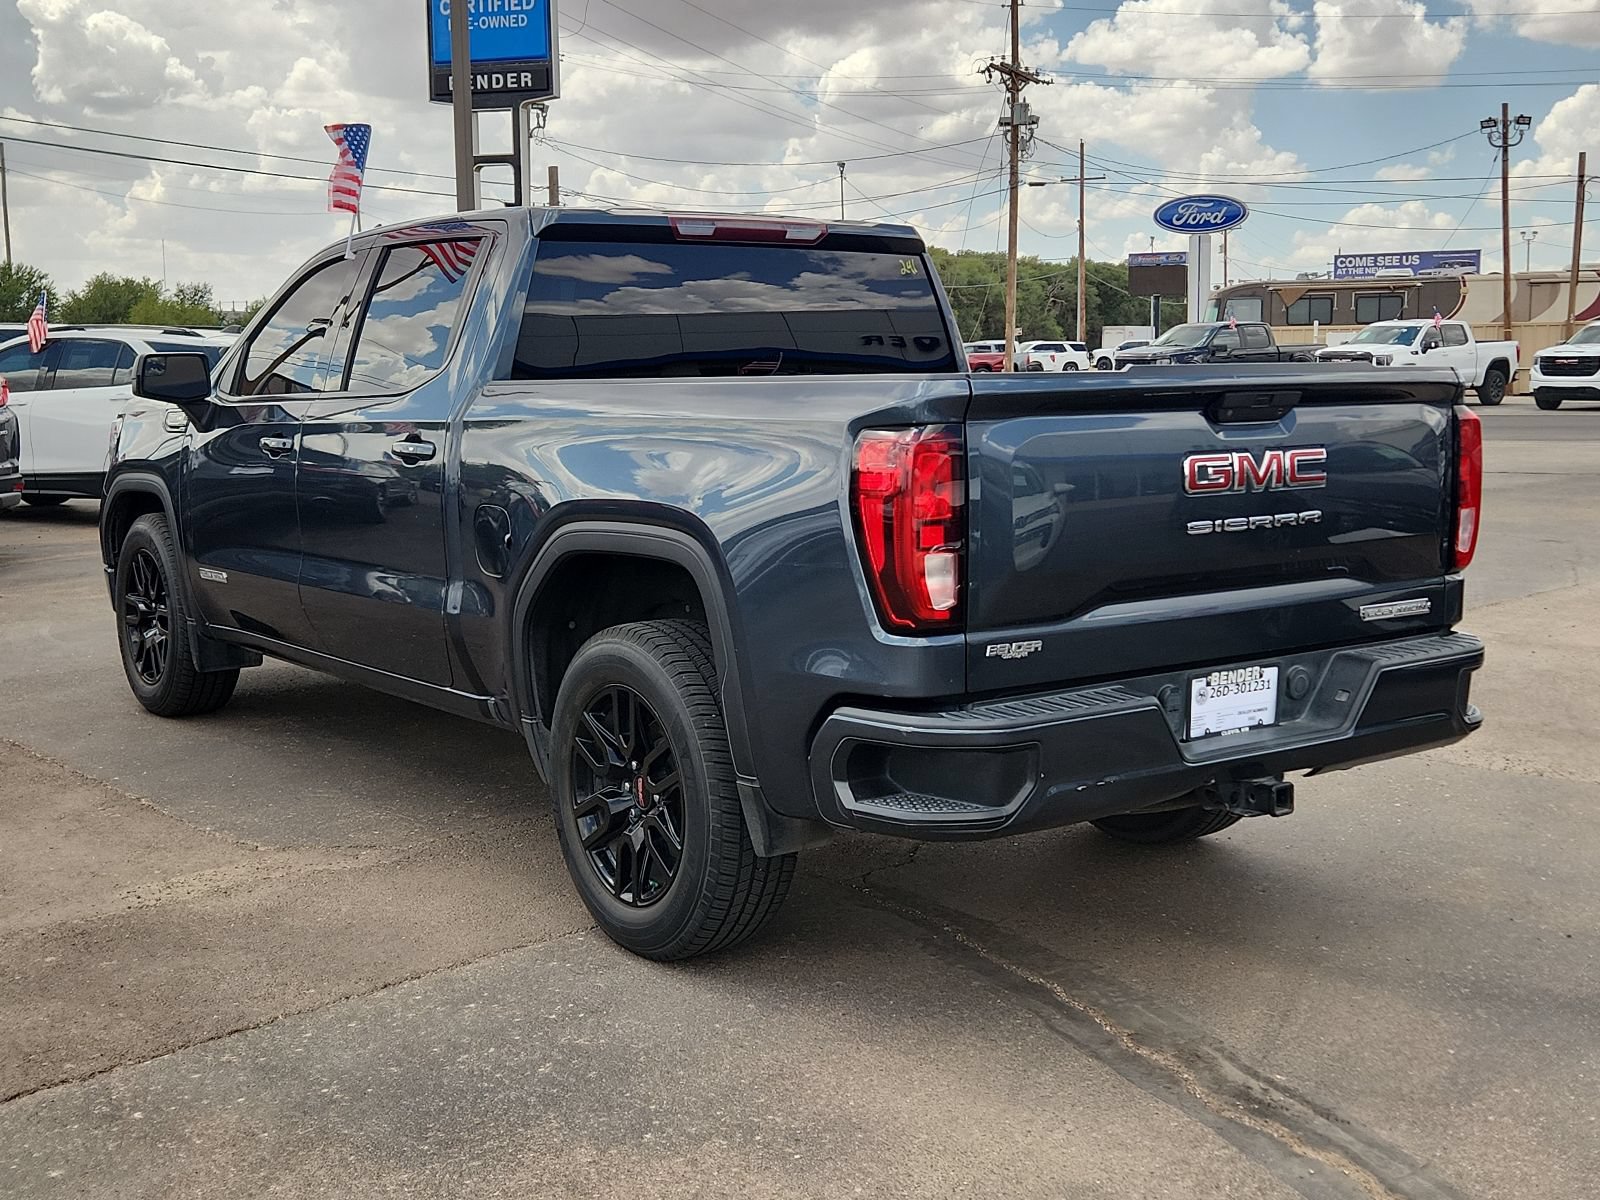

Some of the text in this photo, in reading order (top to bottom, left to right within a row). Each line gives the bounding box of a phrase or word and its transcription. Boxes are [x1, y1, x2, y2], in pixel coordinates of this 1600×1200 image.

[440, 0, 534, 15] CRTIFIED
[448, 14, 528, 31] E-OWNED
[1172, 202, 1228, 226] Ford
[1336, 256, 1375, 268] COME
[1376, 255, 1401, 267] SEE
[1402, 254, 1420, 266] US
[1347, 267, 1364, 275] THE
[1183, 448, 1327, 496] GMC
[1186, 510, 1323, 536] SIERRA
[1210, 666, 1261, 687] BENDER
[1209, 680, 1271, 698] 26D-301231
